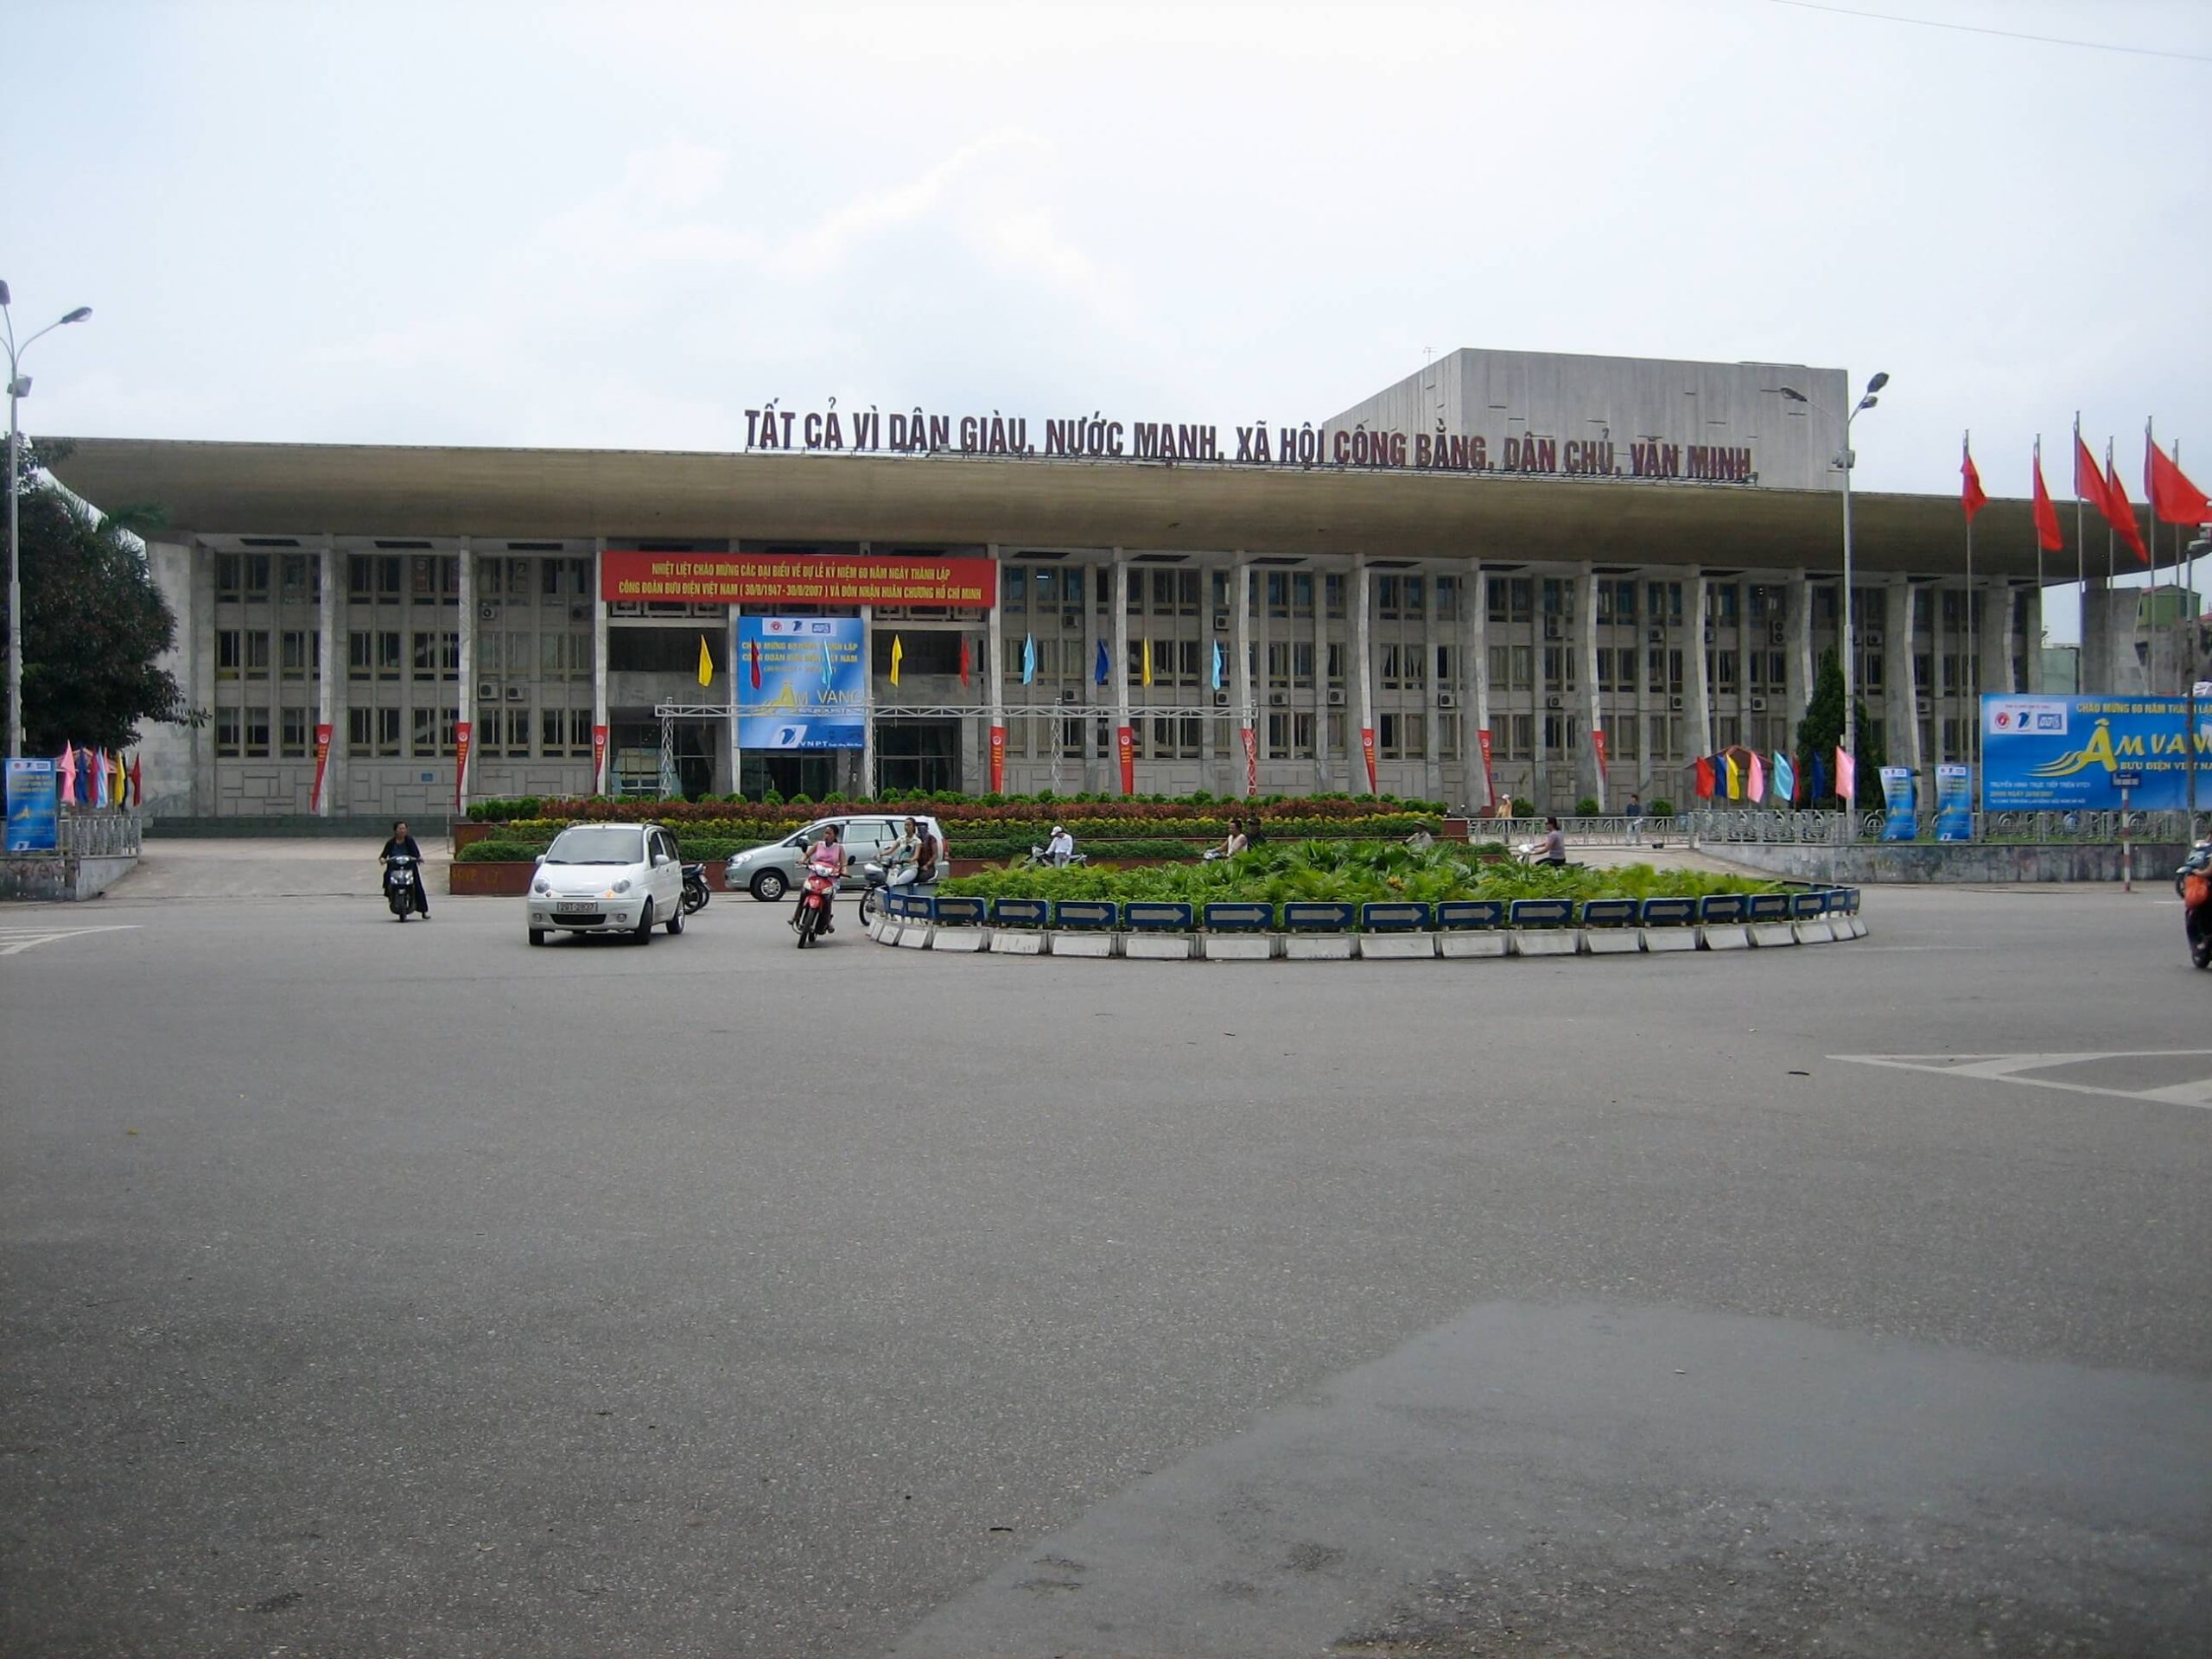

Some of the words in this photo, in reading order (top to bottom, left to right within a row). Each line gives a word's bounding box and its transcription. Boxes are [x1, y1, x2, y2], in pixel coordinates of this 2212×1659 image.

[745, 397, 796, 448] TẤT
[804, 397, 843, 448] CẢ
[853, 405, 880, 450] VÌ
[889, 406, 950, 452] DÂN
[1046, 411, 1123, 456] NƯỚC
[1236, 421, 1271, 462] XÃ
[1281, 422, 1324, 469] HỘI
[1333, 423, 1406, 467] CÔNG
[1503, 431, 1556, 474] DÂN
[1630, 435, 1678, 477] VĂN
[1687, 445, 1751, 480] MINH
[652, 560, 674, 577] NHIỆT
[676, 561, 691, 578] LIỆT
[693, 561, 715, 575] CHÀO
[715, 561, 740, 576] MỪNG
[741, 562, 757, 576] CÁC
[757, 564, 771, 580] ĐẠI
[772, 561, 790, 577] BIỂU
[837, 564, 857, 581] NIỆM
[858, 567, 868, 579] 60
[869, 564, 887, 579] NĂM
[888, 564, 909, 580] NGÀY
[911, 567, 935, 580] THÀNH
[937, 567, 950, 583] LẬP
[619, 579, 640, 594] CÔNG
[641, 579, 663, 594] ĐOÀN
[664, 581, 682, 594] BƯU
[683, 580, 700, 597] ĐIỆN
[702, 580, 718, 597] VIỆT
[720, 582, 738, 595] NAM
[830, 582, 840, 597] VÀ
[947, 585, 960, 599] CHÍ
[962, 587, 982, 600] MINH
